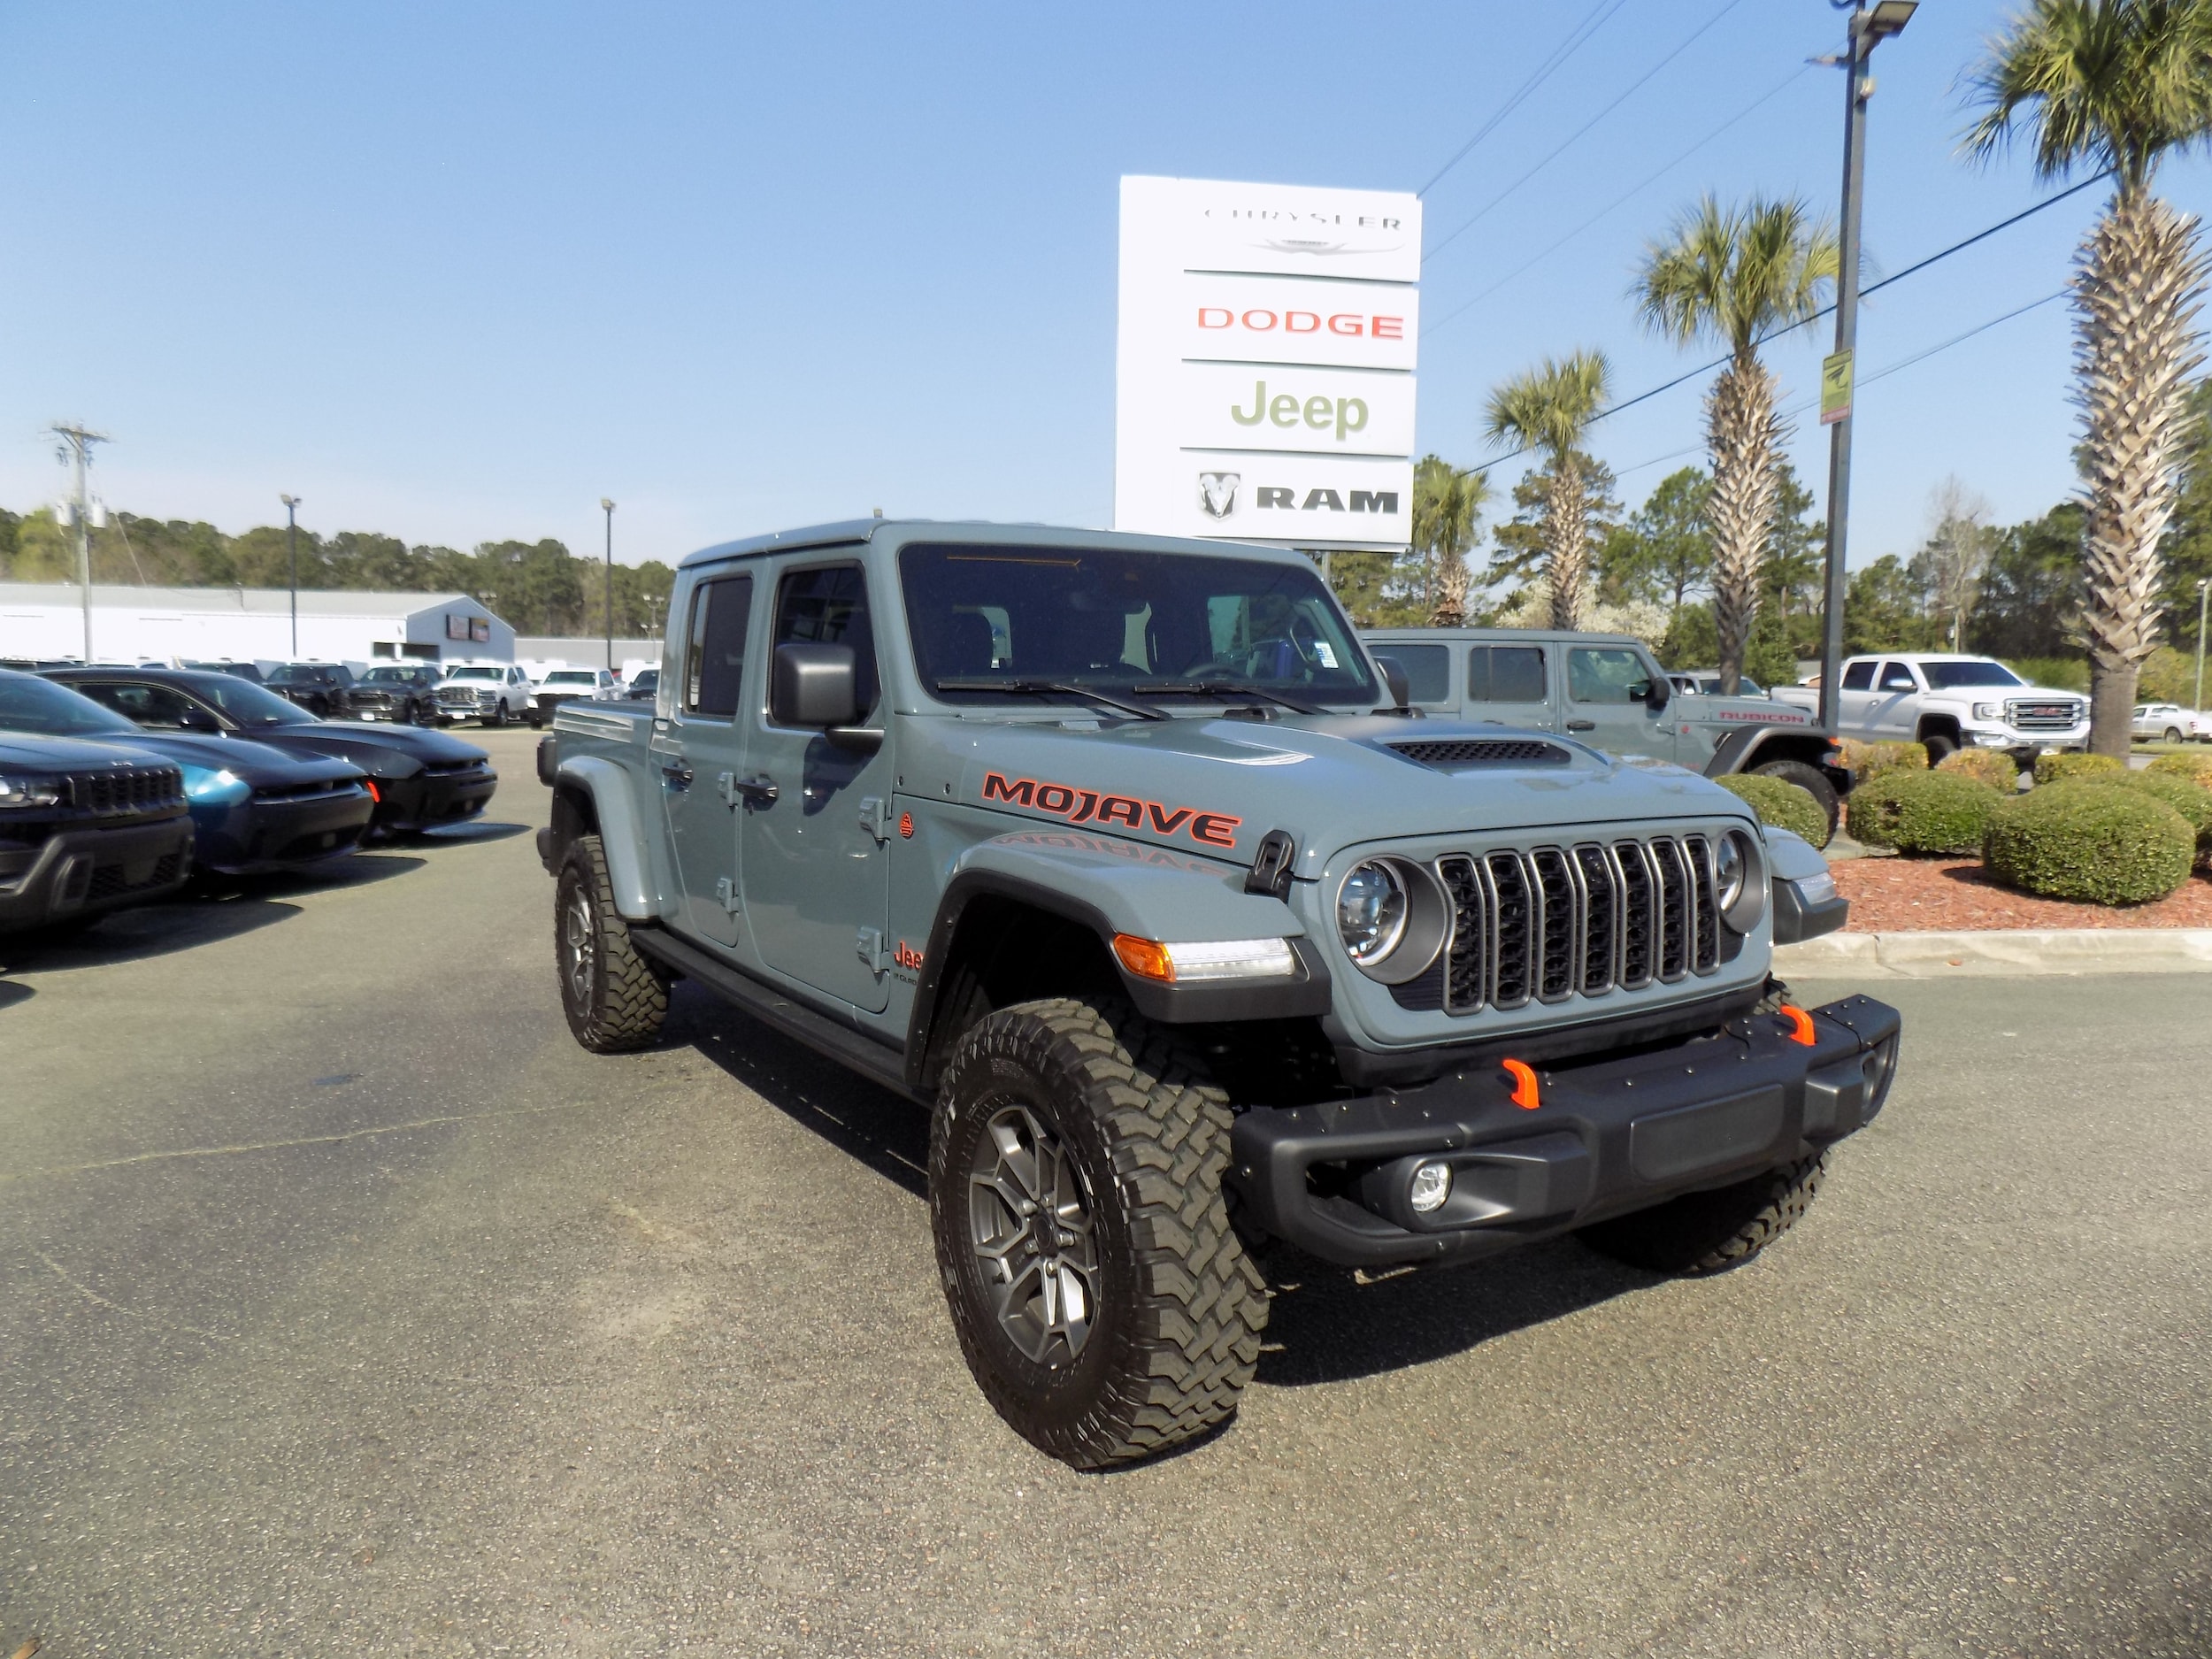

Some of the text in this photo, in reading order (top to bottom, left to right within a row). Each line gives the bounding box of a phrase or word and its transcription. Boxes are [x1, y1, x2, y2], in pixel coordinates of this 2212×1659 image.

[1198, 308, 1404, 341] DODGE
[1231, 380, 1369, 442] Jeep
[1256, 487, 1399, 514] RAM
[1719, 711, 1805, 723] RUBICON
[982, 771, 1242, 849] MOJAVE
[894, 941, 924, 970] Jee
